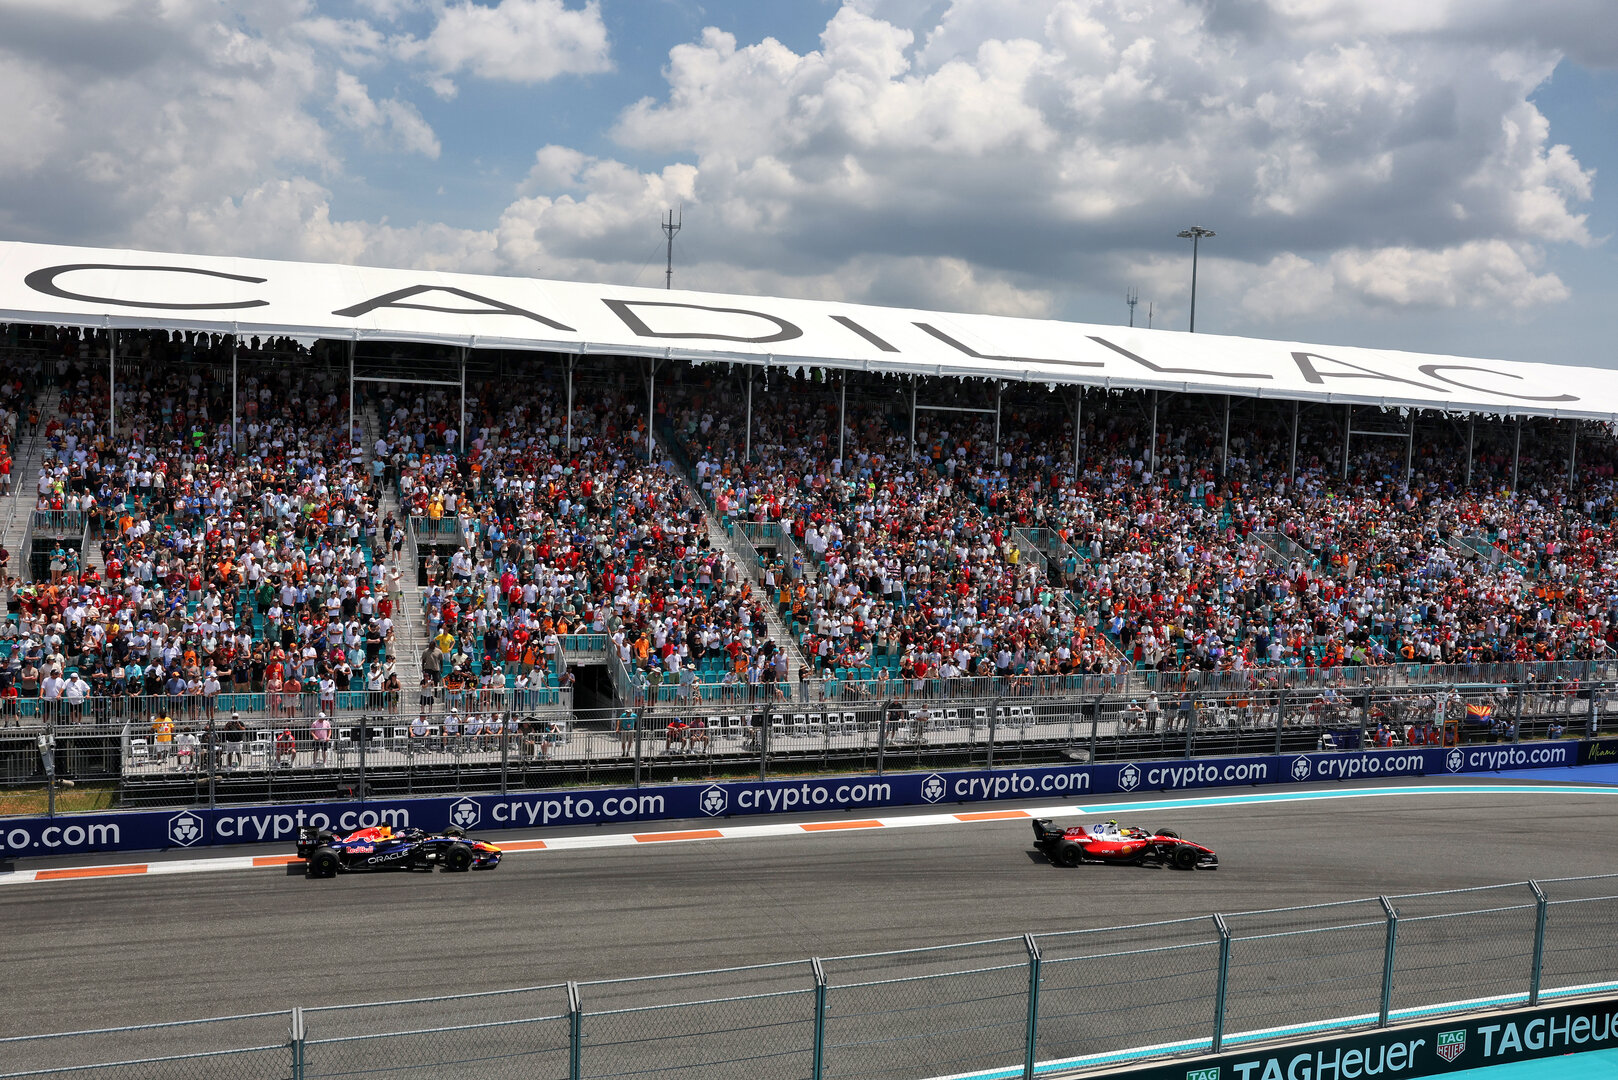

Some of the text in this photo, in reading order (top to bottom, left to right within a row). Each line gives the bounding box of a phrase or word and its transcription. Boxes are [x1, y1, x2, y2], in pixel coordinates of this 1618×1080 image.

[24, 263, 1580, 402] CADILLAC
[1469, 747, 1566, 769] crypto.com
[1588, 742, 1616, 760] Miami
[1147, 763, 1267, 787] crypto.com
[1317, 754, 1424, 778] crypto.com
[954, 772, 1090, 798] crypto.com
[738, 783, 891, 811] crypto.com
[492, 795, 665, 825] crypto.com
[216, 809, 409, 840] crypto.com
[1066, 827, 1080, 835] 44
[367, 849, 409, 864] ORACLE
[1440, 1031, 1464, 1044] TAG
[1438, 1043, 1464, 1058] HEUER
[1189, 1070, 1217, 1080] TAG
